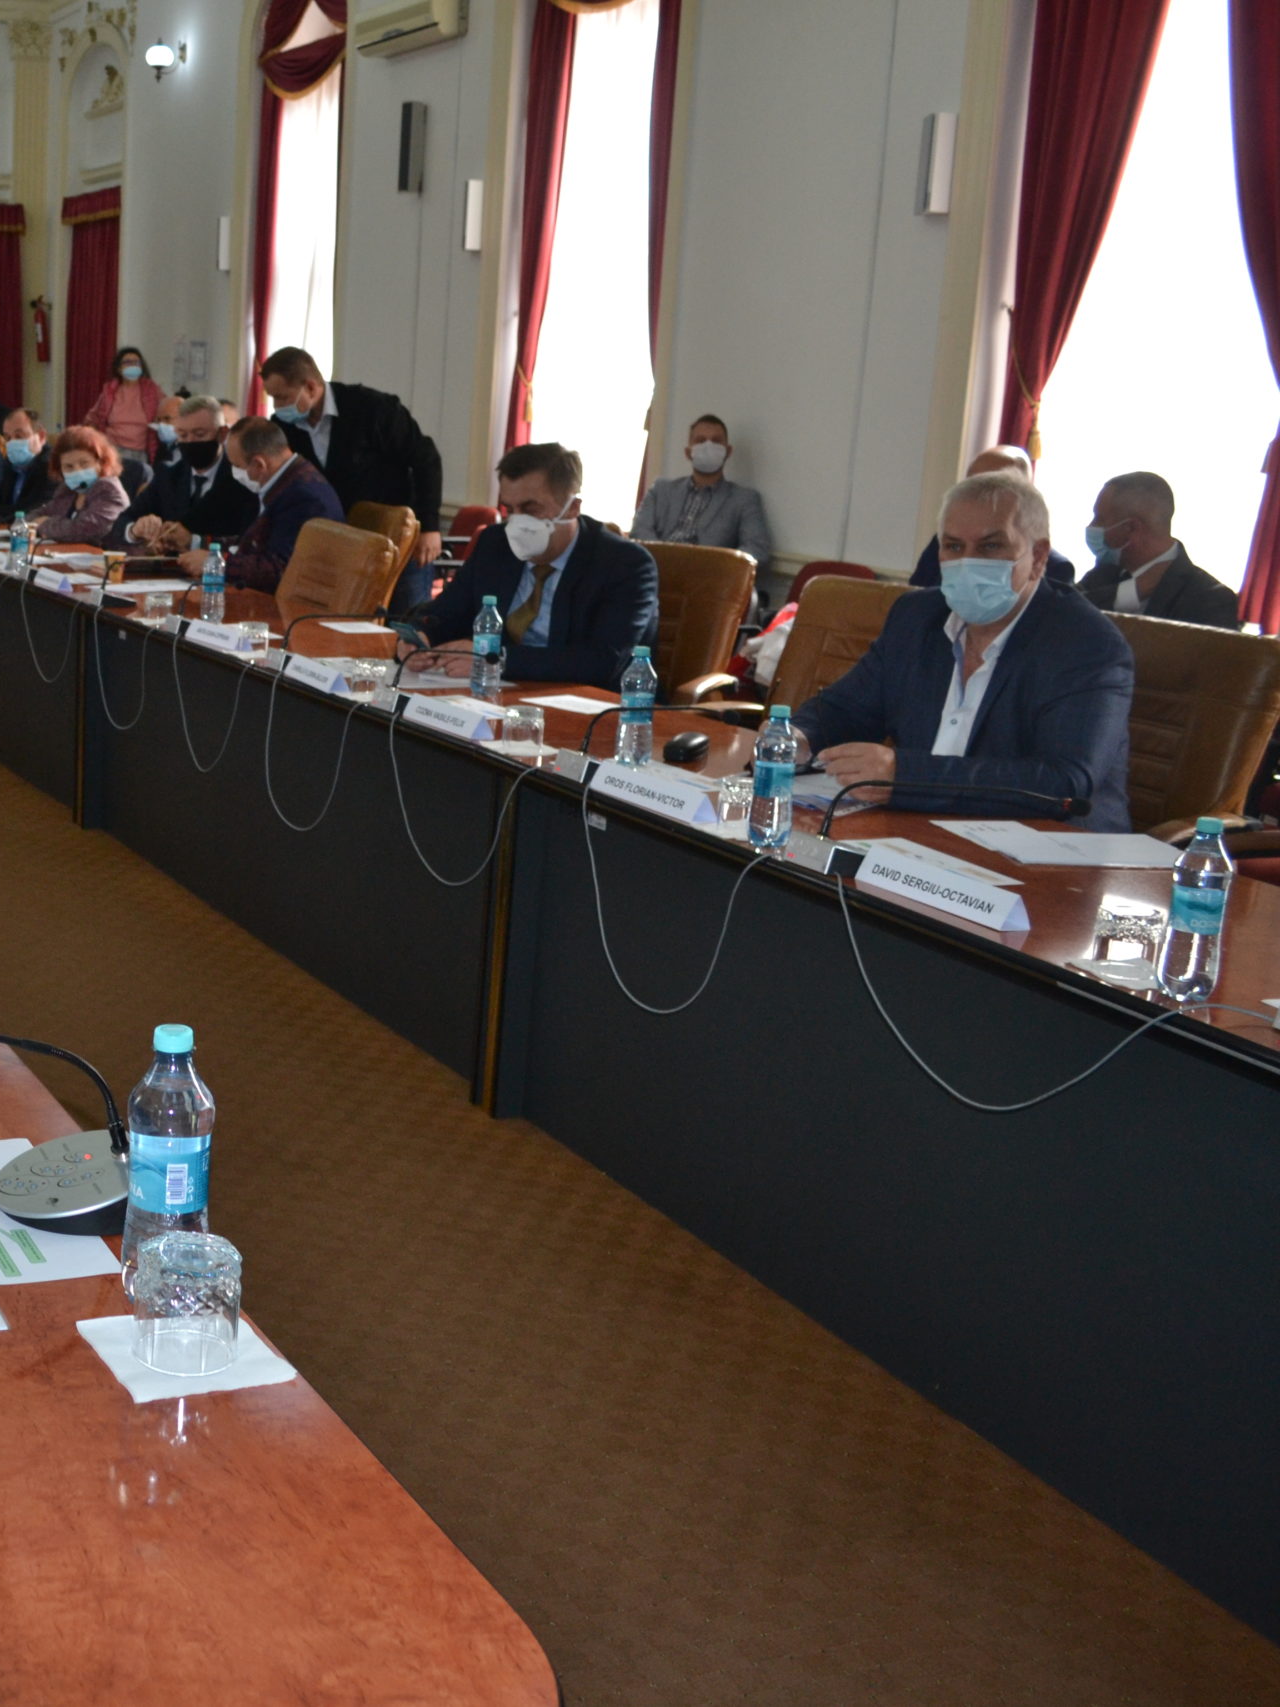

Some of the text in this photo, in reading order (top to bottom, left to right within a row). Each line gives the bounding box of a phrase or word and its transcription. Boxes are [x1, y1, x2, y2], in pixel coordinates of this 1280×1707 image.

[604, 775, 686, 809] OROS FLORIAN-VICTOR
[872, 864, 995, 914] DAVID SERGIU-OCTAVIAN
